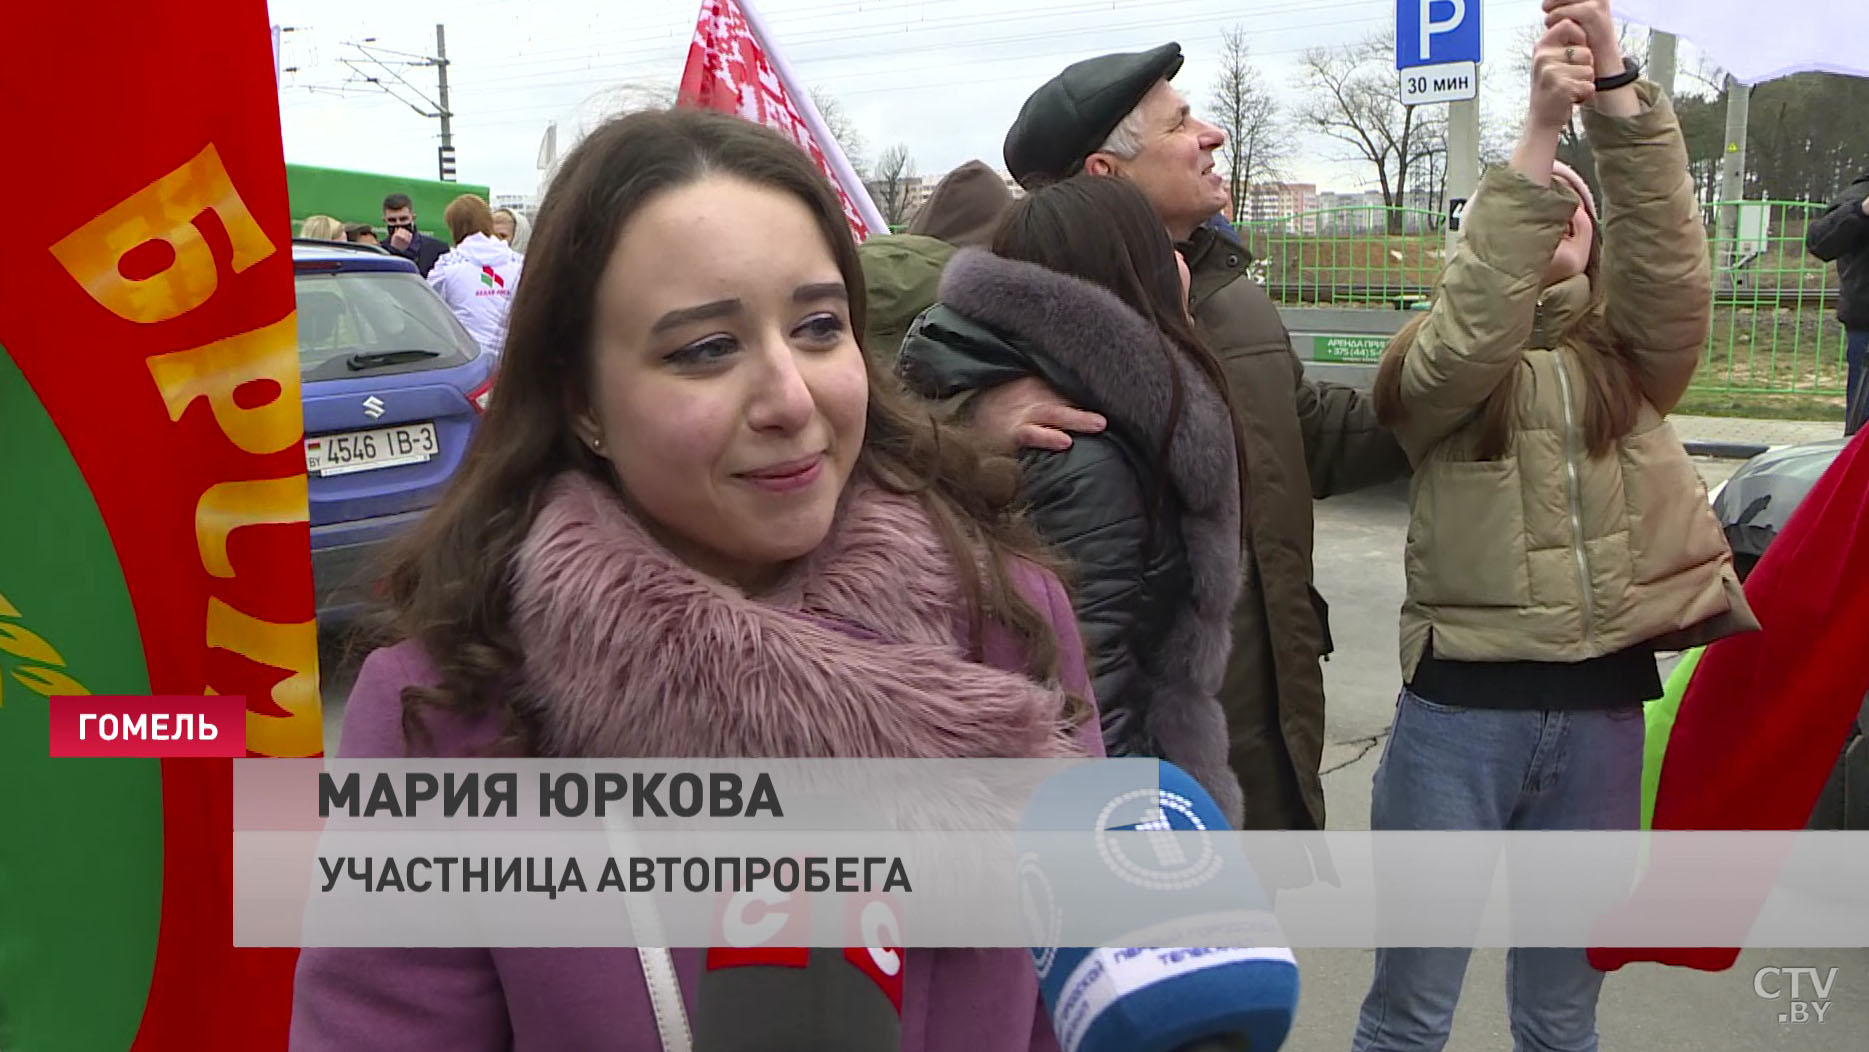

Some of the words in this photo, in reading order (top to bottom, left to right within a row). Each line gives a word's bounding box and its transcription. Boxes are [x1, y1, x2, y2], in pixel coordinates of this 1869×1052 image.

[1419, 0, 1466, 60] P
[1407, 76, 1428, 95] 30
[328, 434, 377, 464] 4546
[387, 427, 434, 456] IB-3
[309, 456, 321, 468] BY
